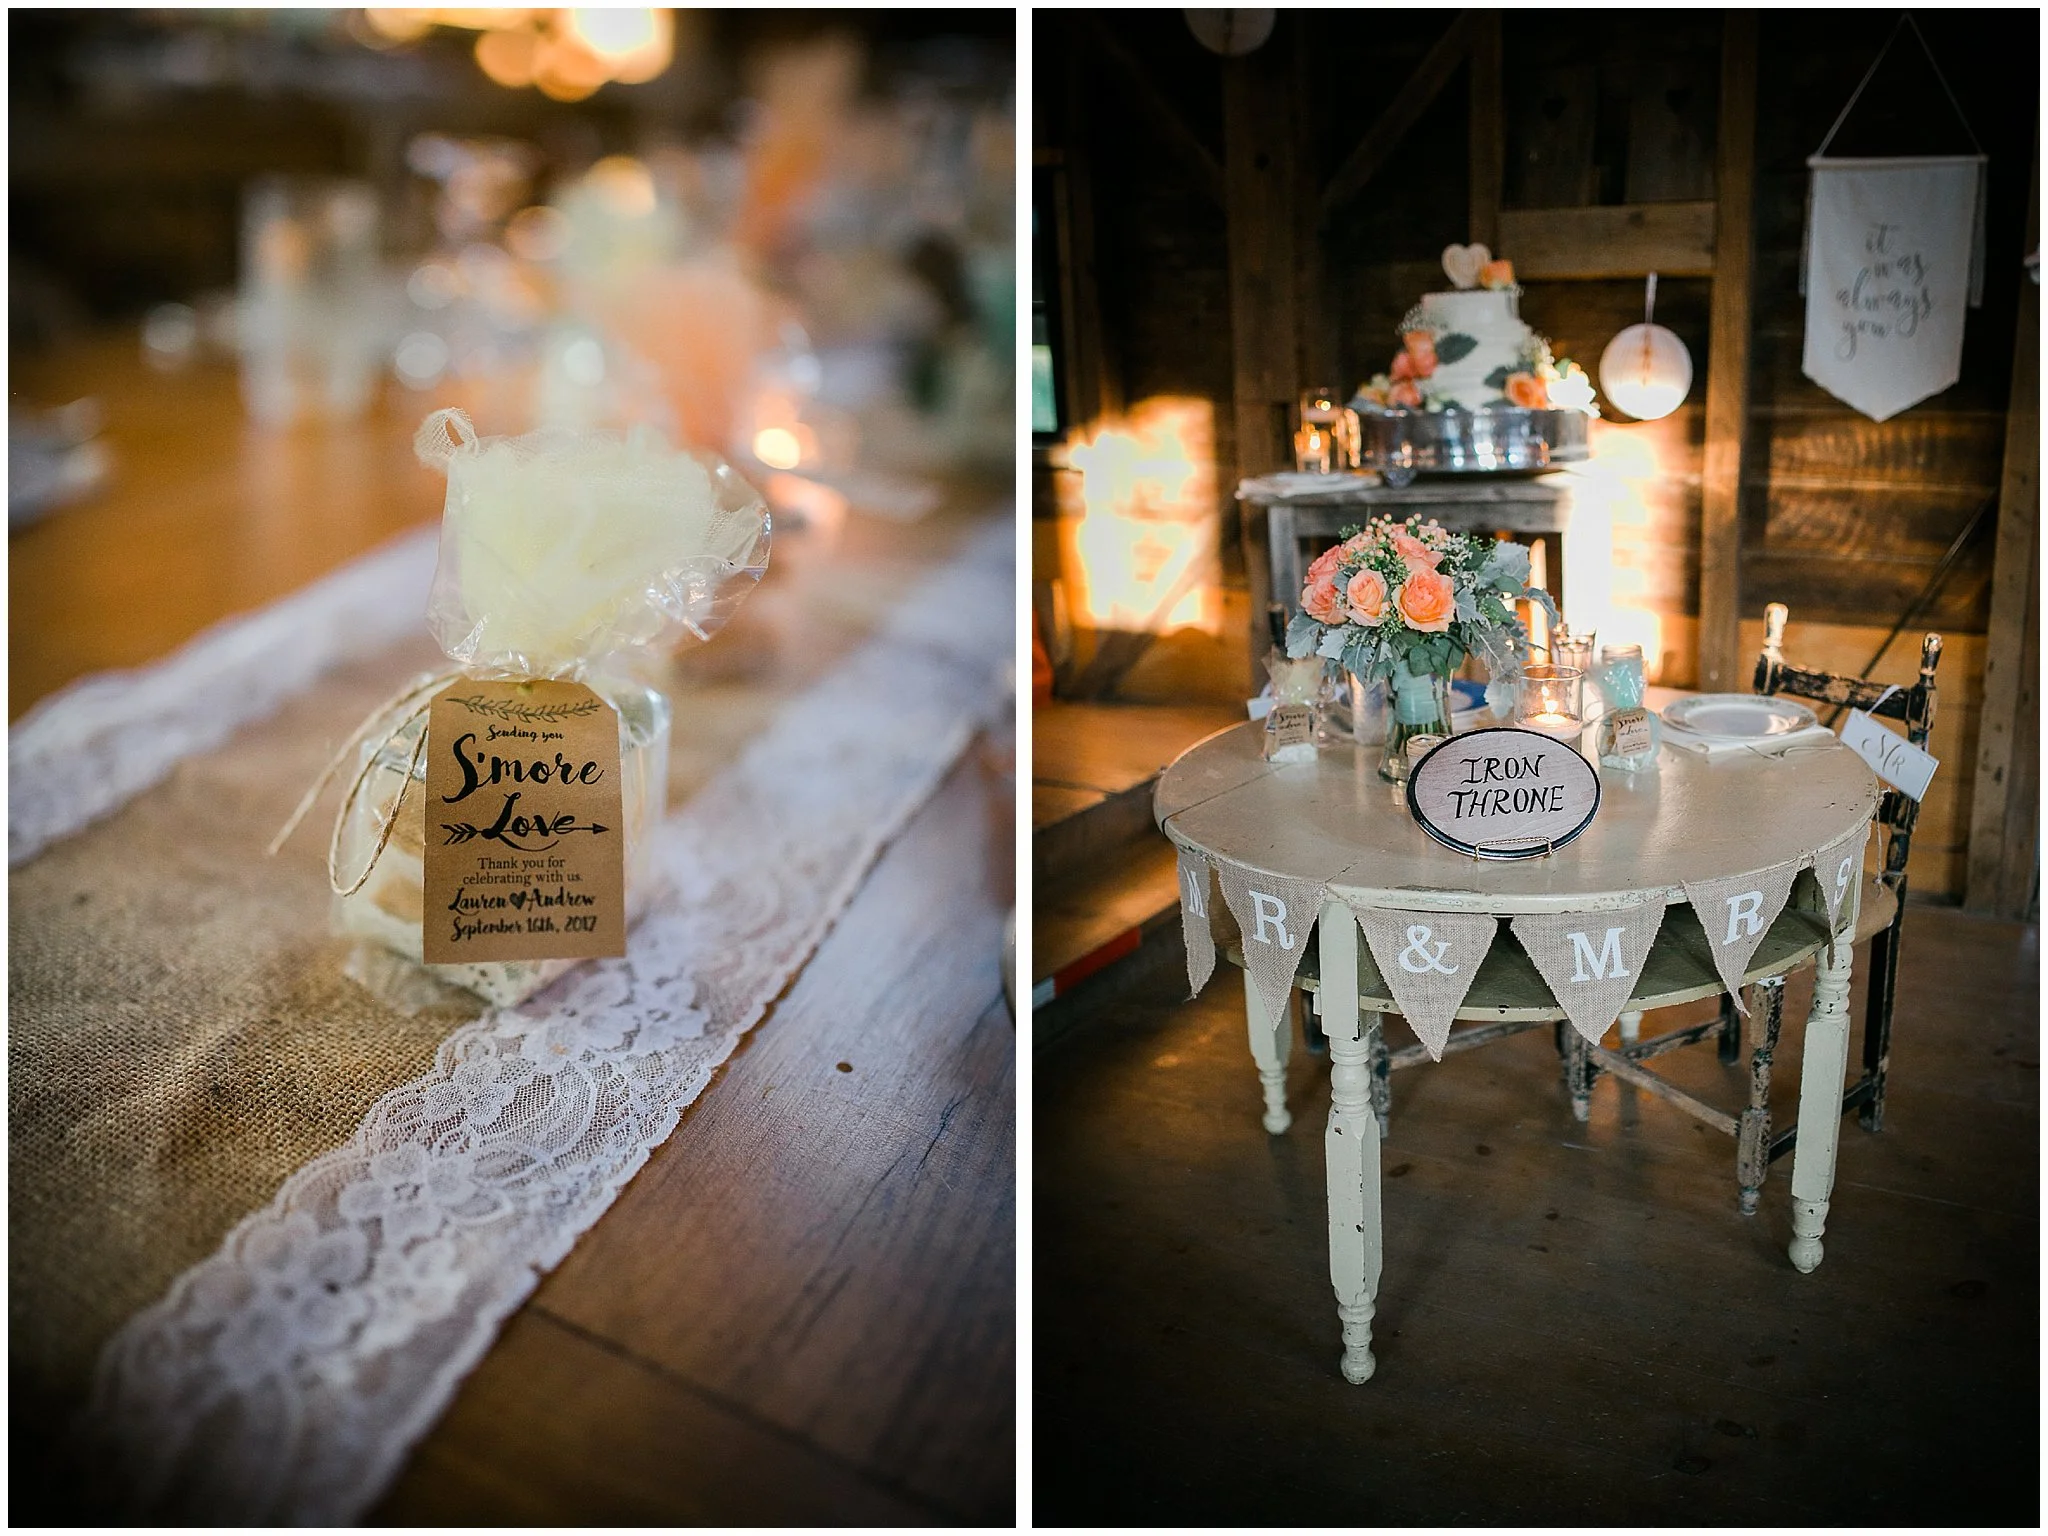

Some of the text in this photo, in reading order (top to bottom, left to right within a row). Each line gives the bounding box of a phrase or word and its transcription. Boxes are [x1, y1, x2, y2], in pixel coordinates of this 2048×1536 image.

[1873, 250, 1932, 287] was
[1836, 266, 1936, 339] always
[1833, 319, 1892, 363] you
[485, 724, 565, 743] Sending you
[441, 733, 605, 804] S'more
[1459, 754, 1546, 785] IRON
[1447, 785, 1565, 820] THRONE
[480, 792, 576, 852] Love
[462, 871, 532, 887] celebrating
[535, 870, 563, 883] with
[477, 856, 566, 872] Thank you for
[448, 886, 596, 917] Lauren Andrew
[450, 916, 523, 942] September
[563, 915, 598, 932] 2017
[1397, 924, 1459, 976] &
